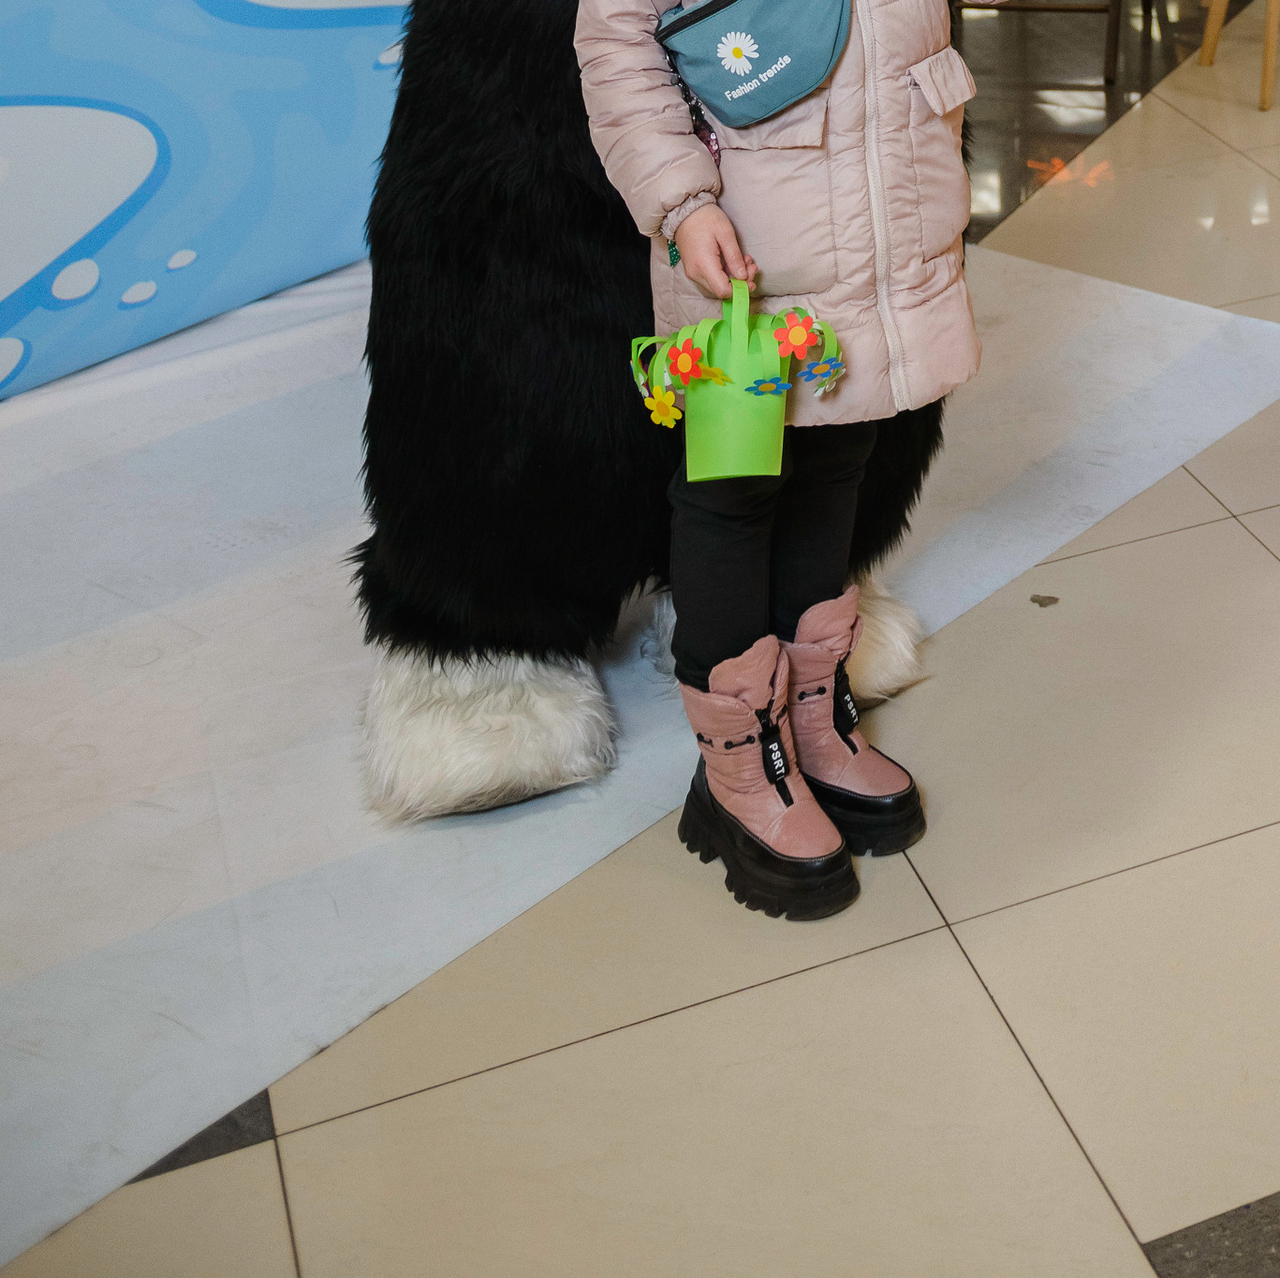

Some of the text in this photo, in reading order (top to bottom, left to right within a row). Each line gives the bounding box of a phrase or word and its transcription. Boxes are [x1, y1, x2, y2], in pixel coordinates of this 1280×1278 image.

[724, 54, 792, 101] Fashion trends
[769, 742, 786, 781] PSRT
